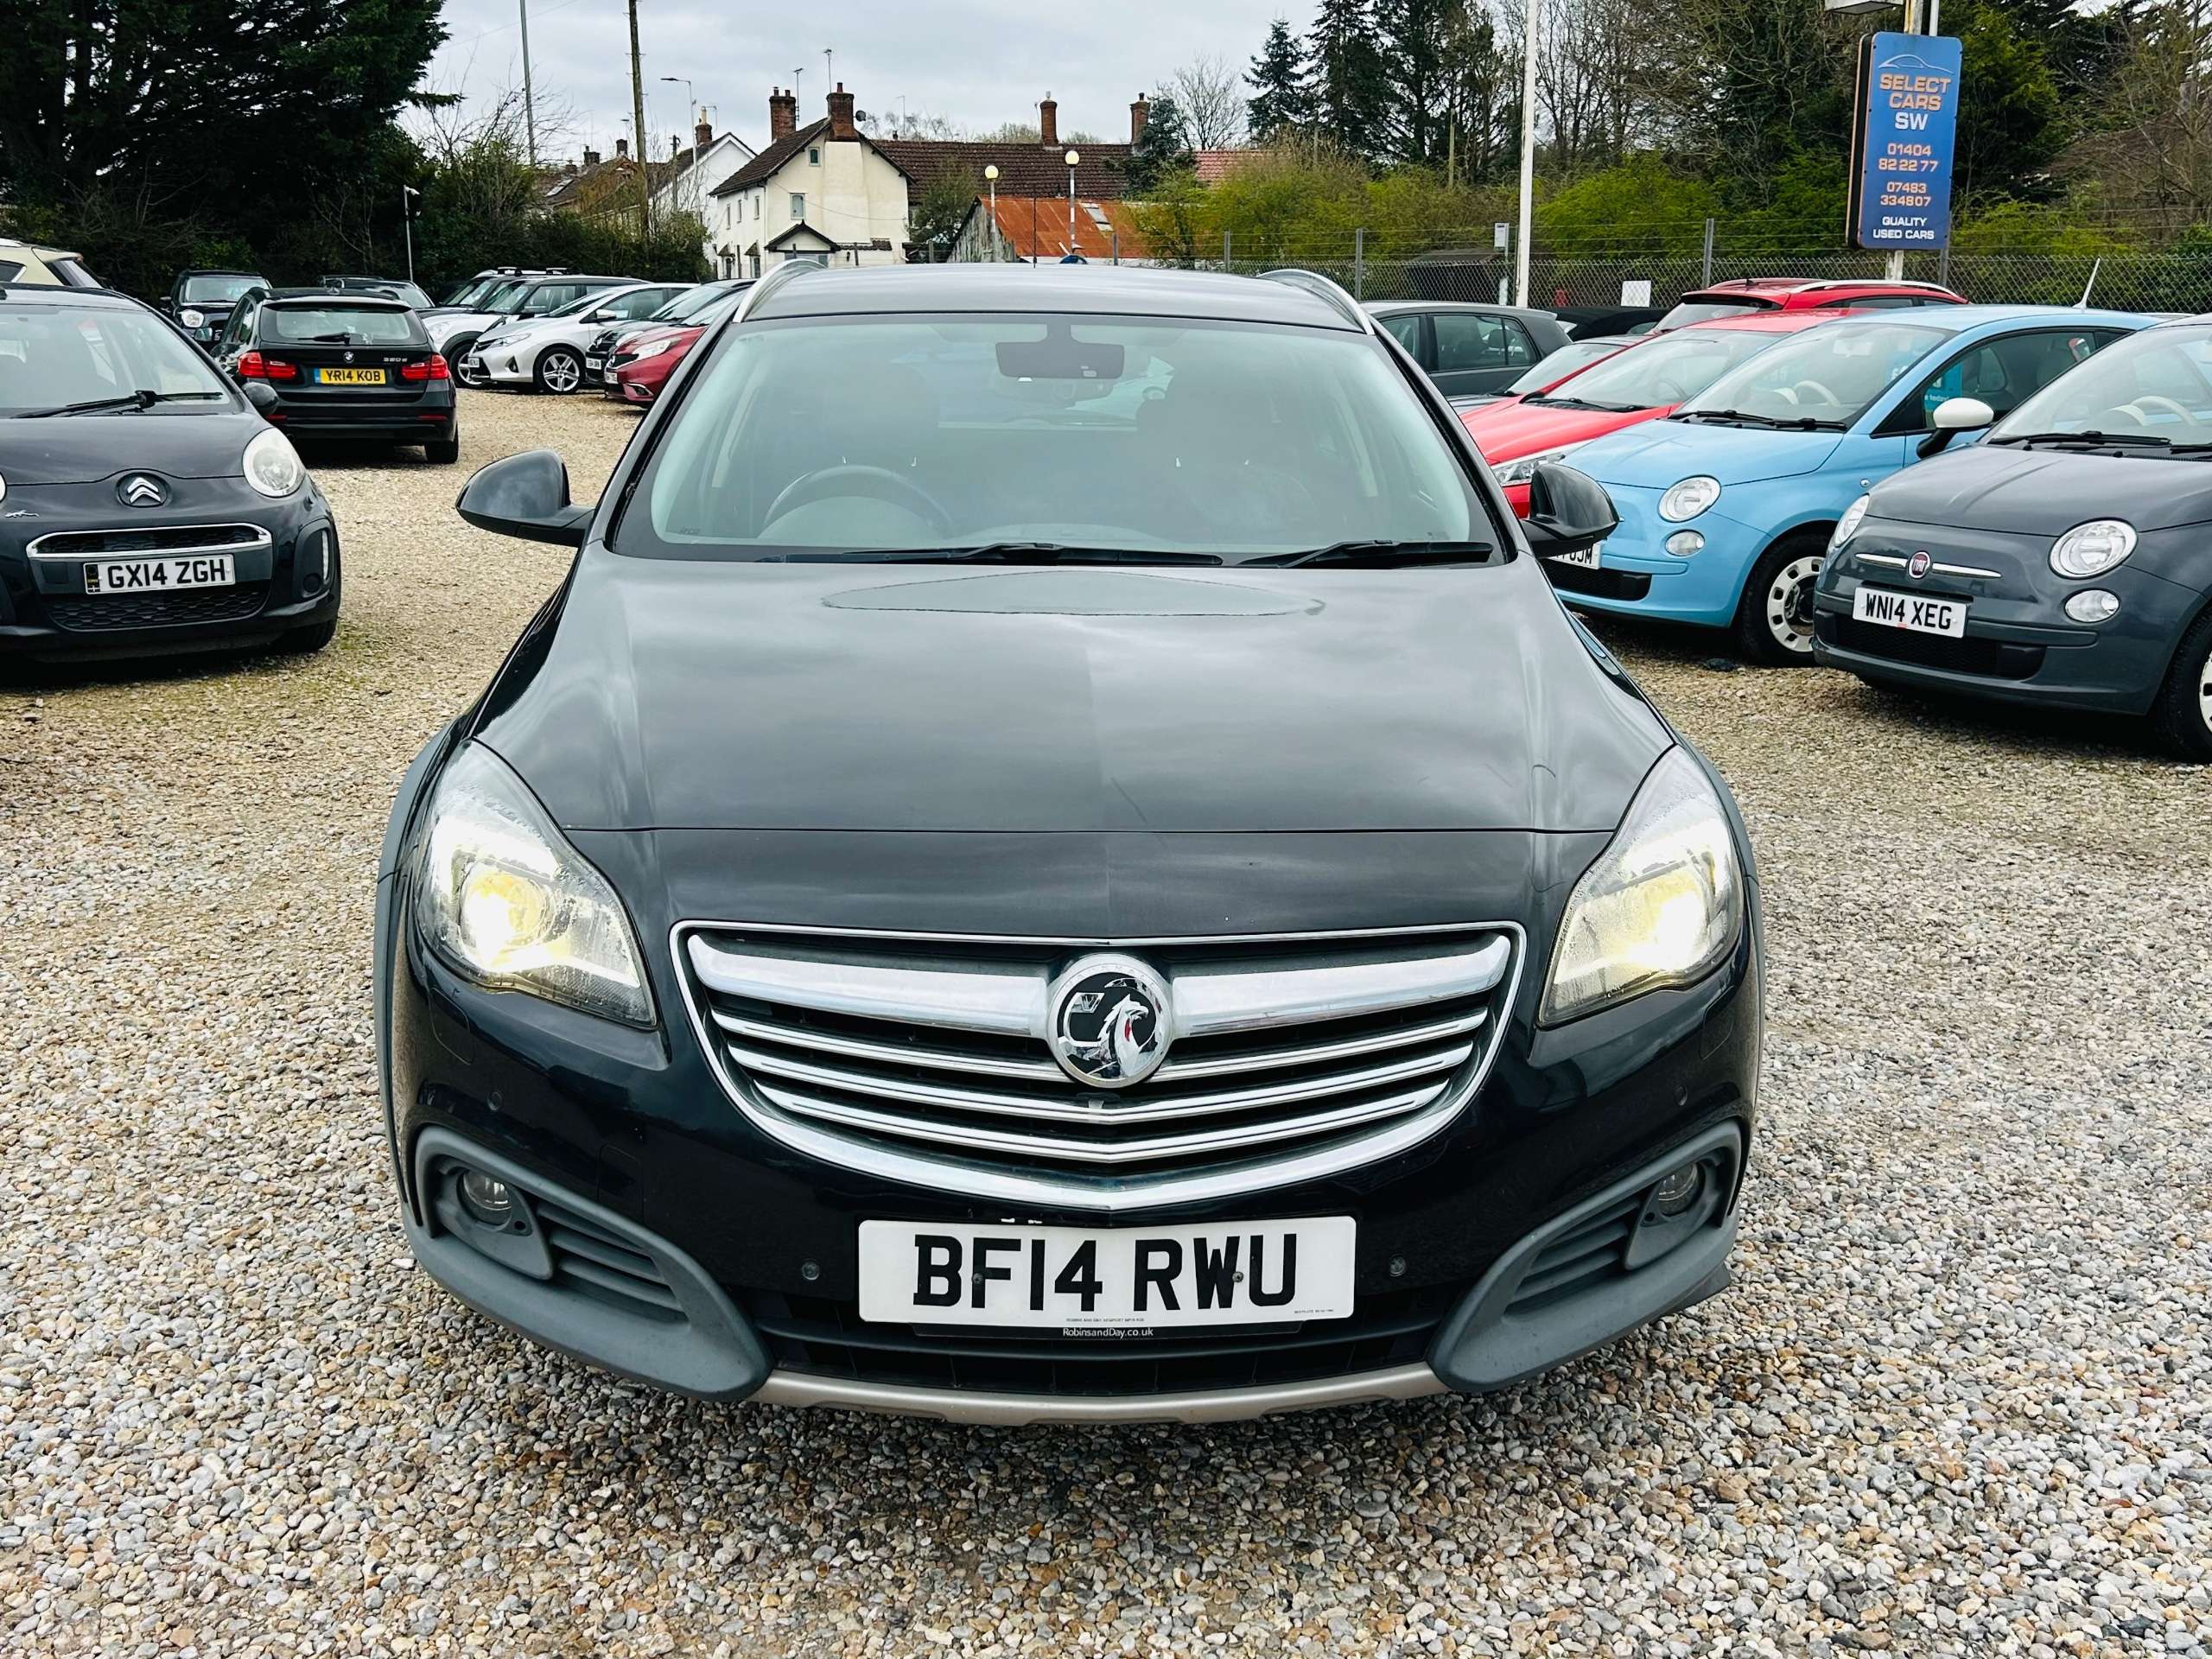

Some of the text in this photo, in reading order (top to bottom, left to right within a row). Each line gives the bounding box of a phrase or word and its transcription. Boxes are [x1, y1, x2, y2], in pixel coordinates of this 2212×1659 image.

[1879, 73, 1951, 93] SELECT
[1889, 92, 1942, 111] CARS
[1895, 111, 1928, 130] SW
[1887, 143, 1932, 156] 01404
[1886, 181, 1927, 194] 07483
[1880, 194, 1932, 207] 334807
[1882, 216, 1928, 227] QUALITY
[1872, 228, 1935, 239] USED CARS
[326, 370, 381, 382] YR14 KOB
[107, 558, 226, 588] GX14 ZGH
[1866, 593, 1952, 630] WN14 XEG
[913, 1233, 1297, 1312] BF14 RWU
[1063, 1327, 1154, 1339] RobinsandDay.co.uk
